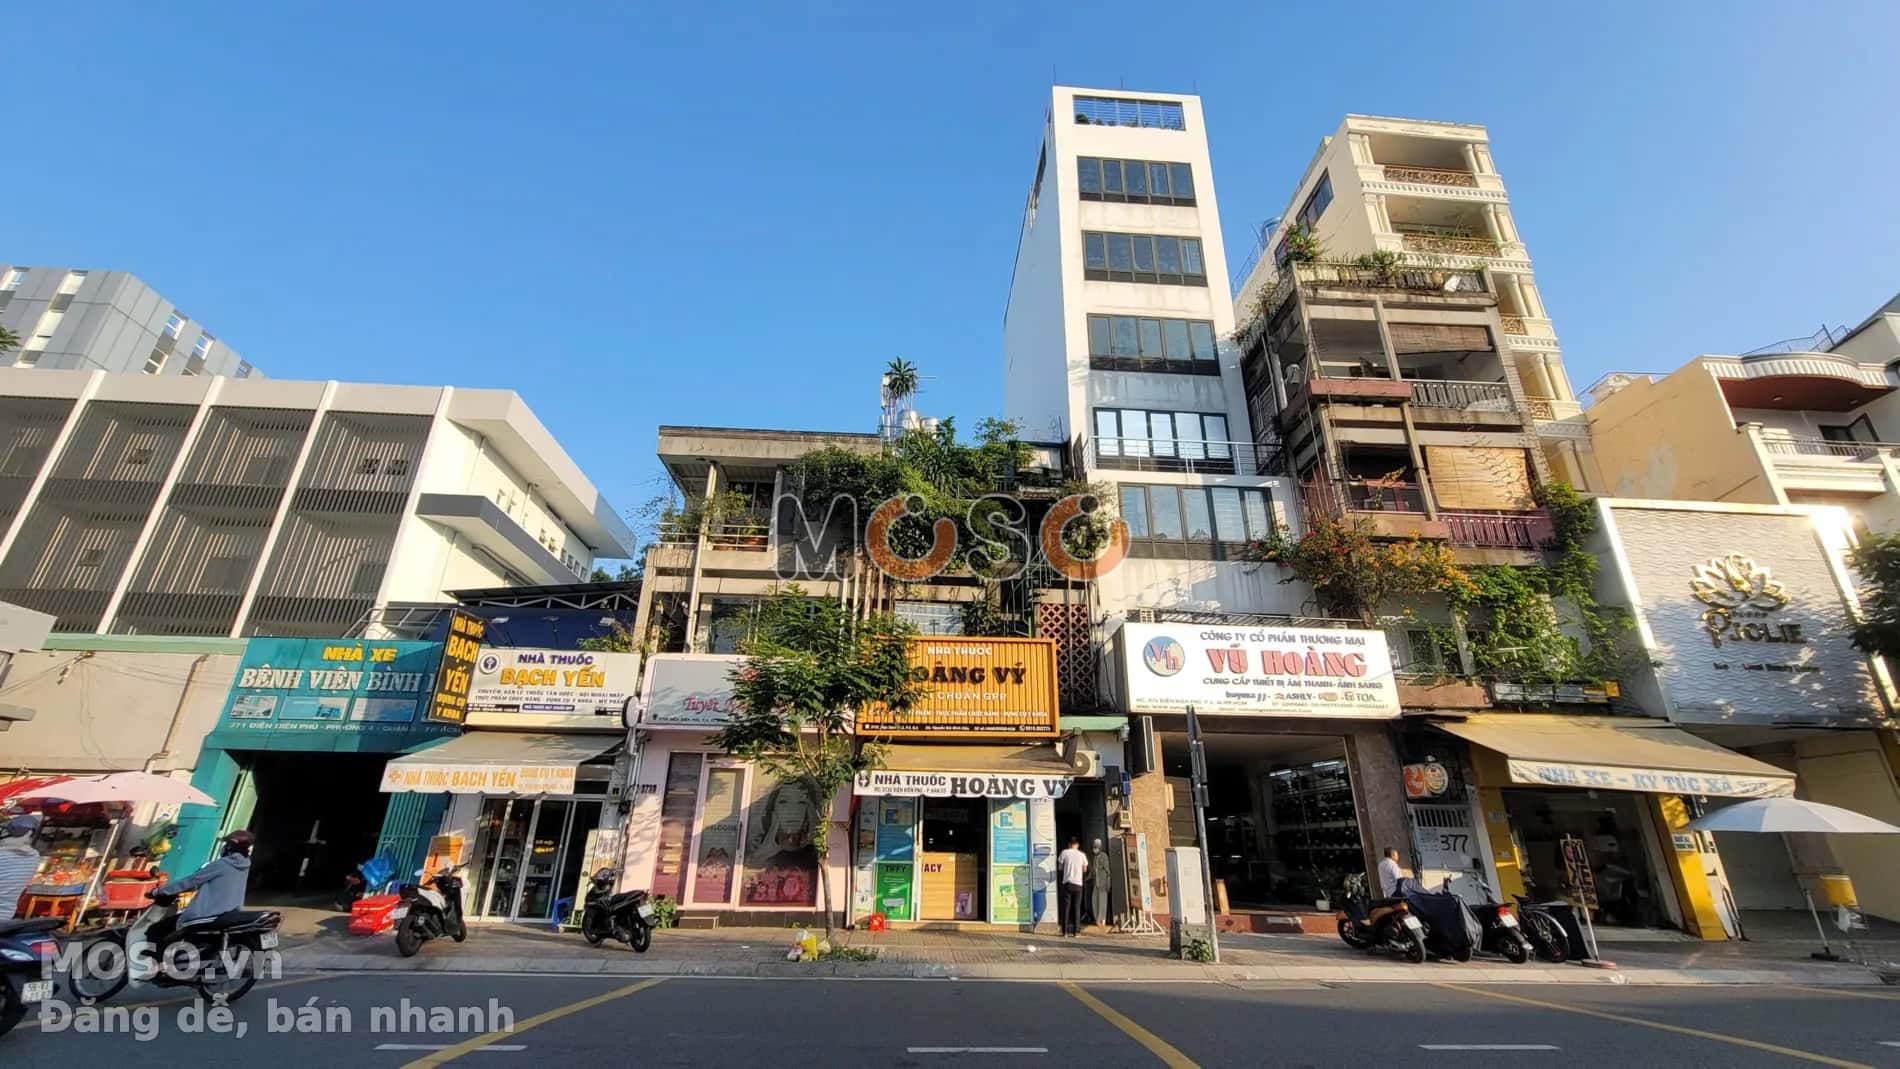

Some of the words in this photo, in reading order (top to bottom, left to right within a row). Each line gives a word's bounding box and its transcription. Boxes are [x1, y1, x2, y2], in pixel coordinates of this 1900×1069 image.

[447, 634, 480, 663] BẠCH
[1200, 630, 1232, 642] CÔNG
[1235, 632, 1246, 642] TY
[1345, 636, 1365, 647] MẠI
[322, 643, 363, 662] NHÀ
[368, 648, 398, 662] XE
[518, 652, 545, 665] NHÀ
[550, 652, 594, 666] THUỐC
[1206, 643, 1249, 674] VŨ
[1261, 644, 1369, 678] HOÀNG
[238, 663, 305, 693] BỆNH
[309, 665, 364, 695] VIỆN
[366, 665, 423, 693] BÌNH
[445, 665, 470, 694] YẾN
[499, 668, 557, 688] BẠCH
[563, 664, 606, 688] YẾN
[911, 661, 985, 685] OÀNG
[1203, 677, 1230, 685] CUNG
[452, 770, 486, 787] BẠCH
[492, 767, 516, 787] YẾN
[874, 774, 900, 785] NHÀ
[905, 774, 946, 786] THUỐC
[951, 774, 1035, 796] HOÀNG
[1583, 770, 1612, 785] XE
[1663, 771, 1701, 791] TÚC
[1440, 834, 1468, 854] 377
